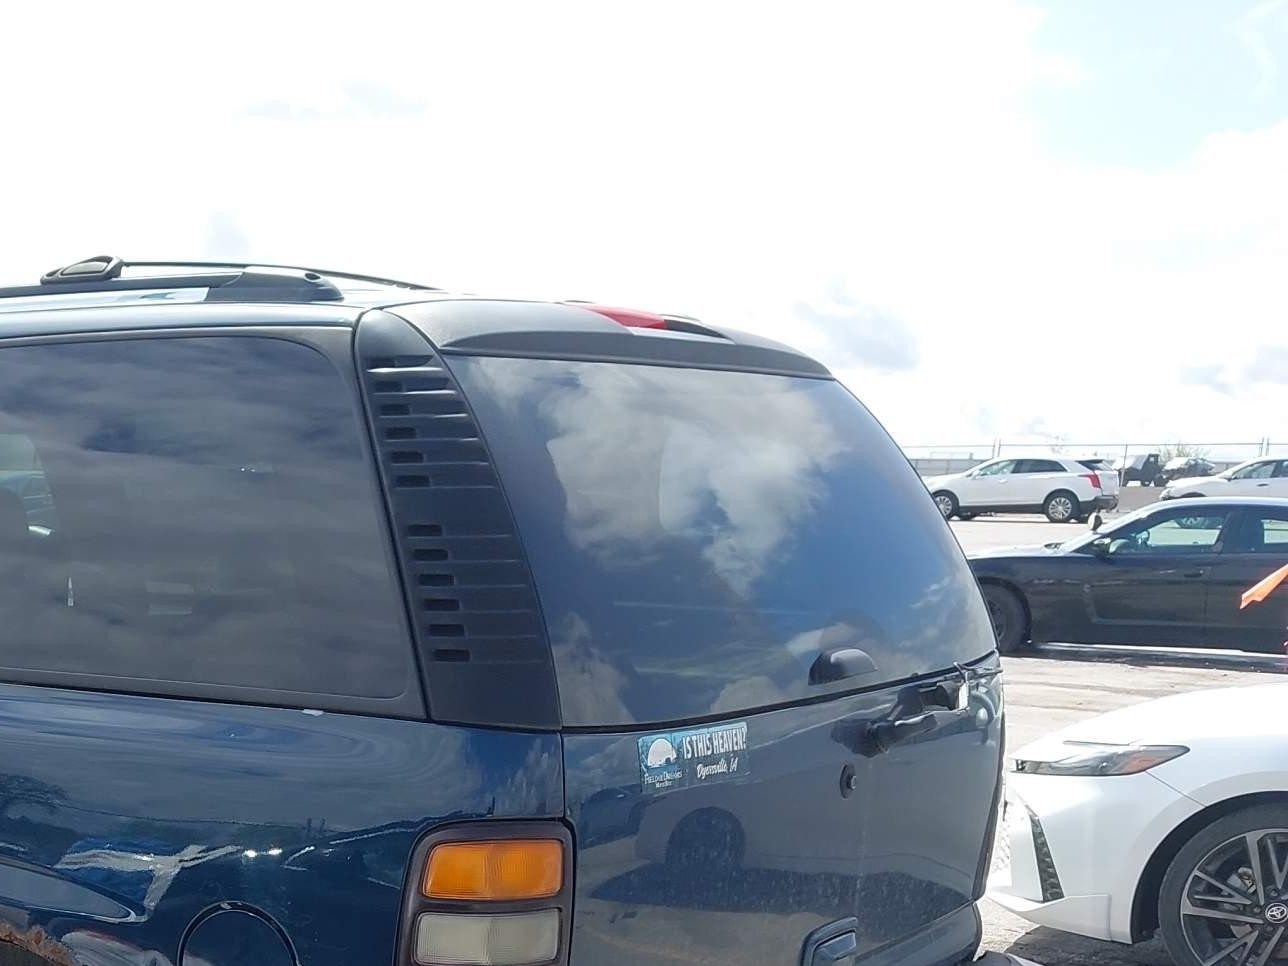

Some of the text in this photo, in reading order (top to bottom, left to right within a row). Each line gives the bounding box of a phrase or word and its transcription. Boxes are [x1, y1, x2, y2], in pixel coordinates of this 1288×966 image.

[683, 727, 747, 759] IS THIS HEAVEN?
